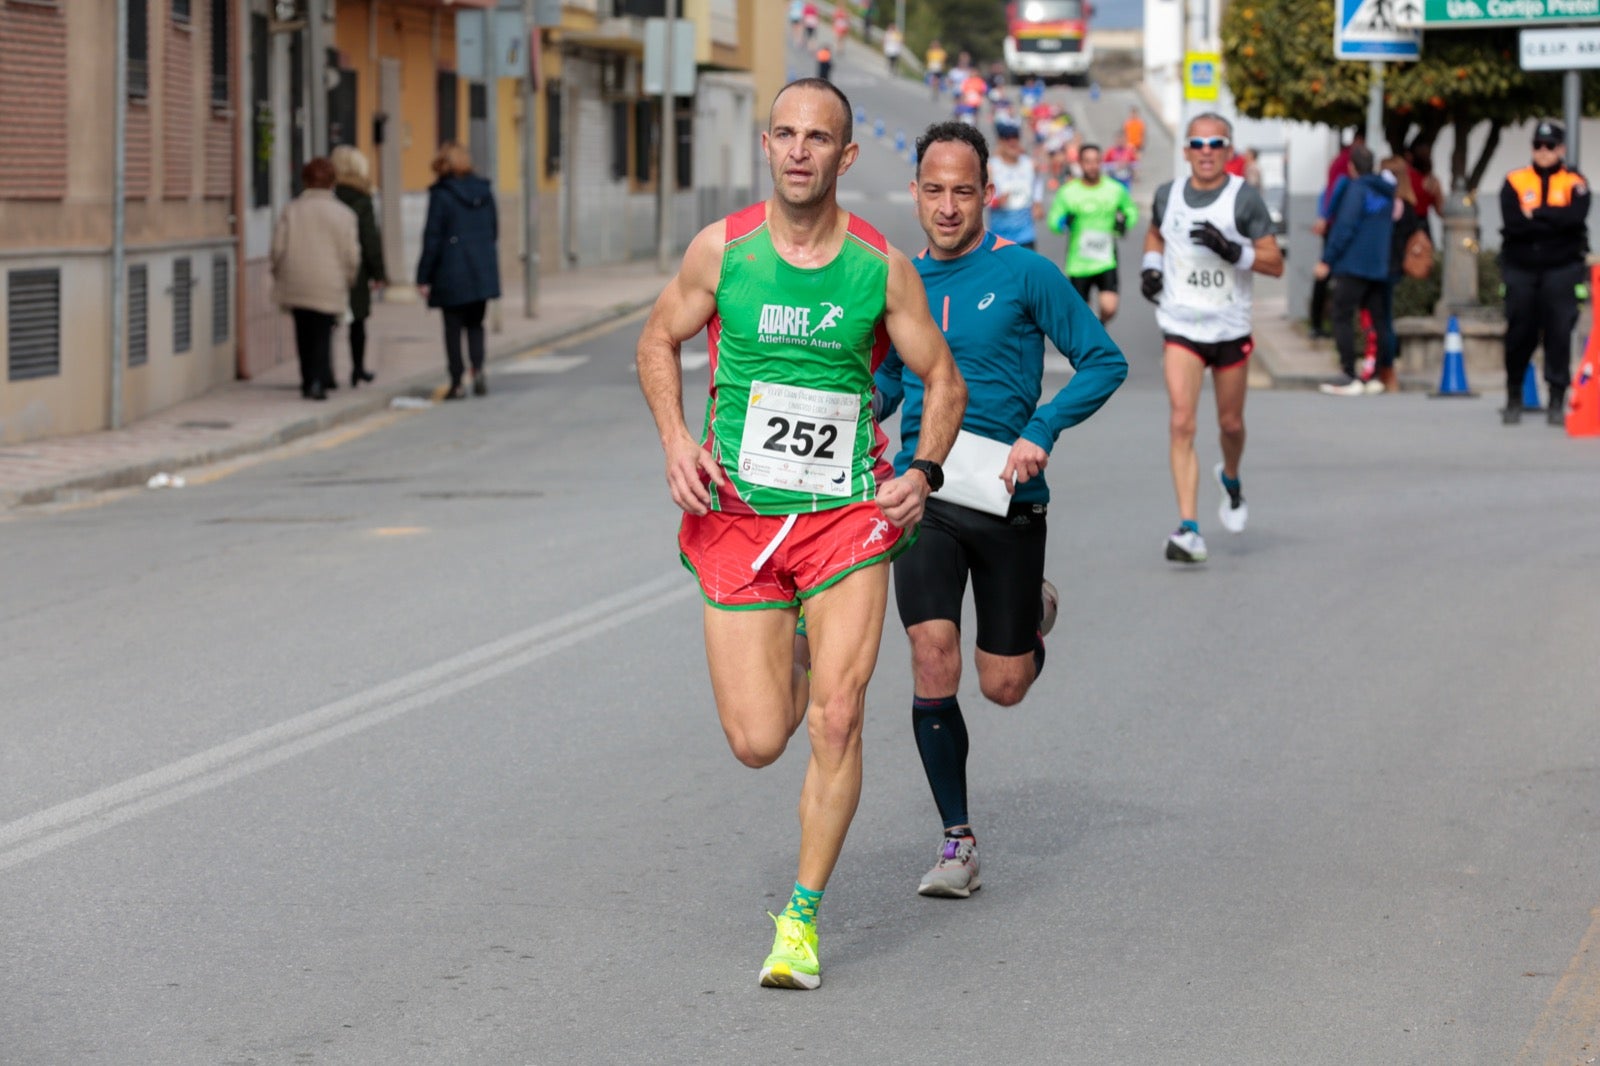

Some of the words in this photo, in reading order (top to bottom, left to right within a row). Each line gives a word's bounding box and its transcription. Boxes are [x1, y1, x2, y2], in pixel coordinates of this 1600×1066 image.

[1187, 269, 1225, 289] 480
[757, 304, 811, 337] ATARFE
[758, 335, 807, 346] Atletismo
[810, 338, 842, 350] Atarfe
[763, 416, 838, 459] 252
